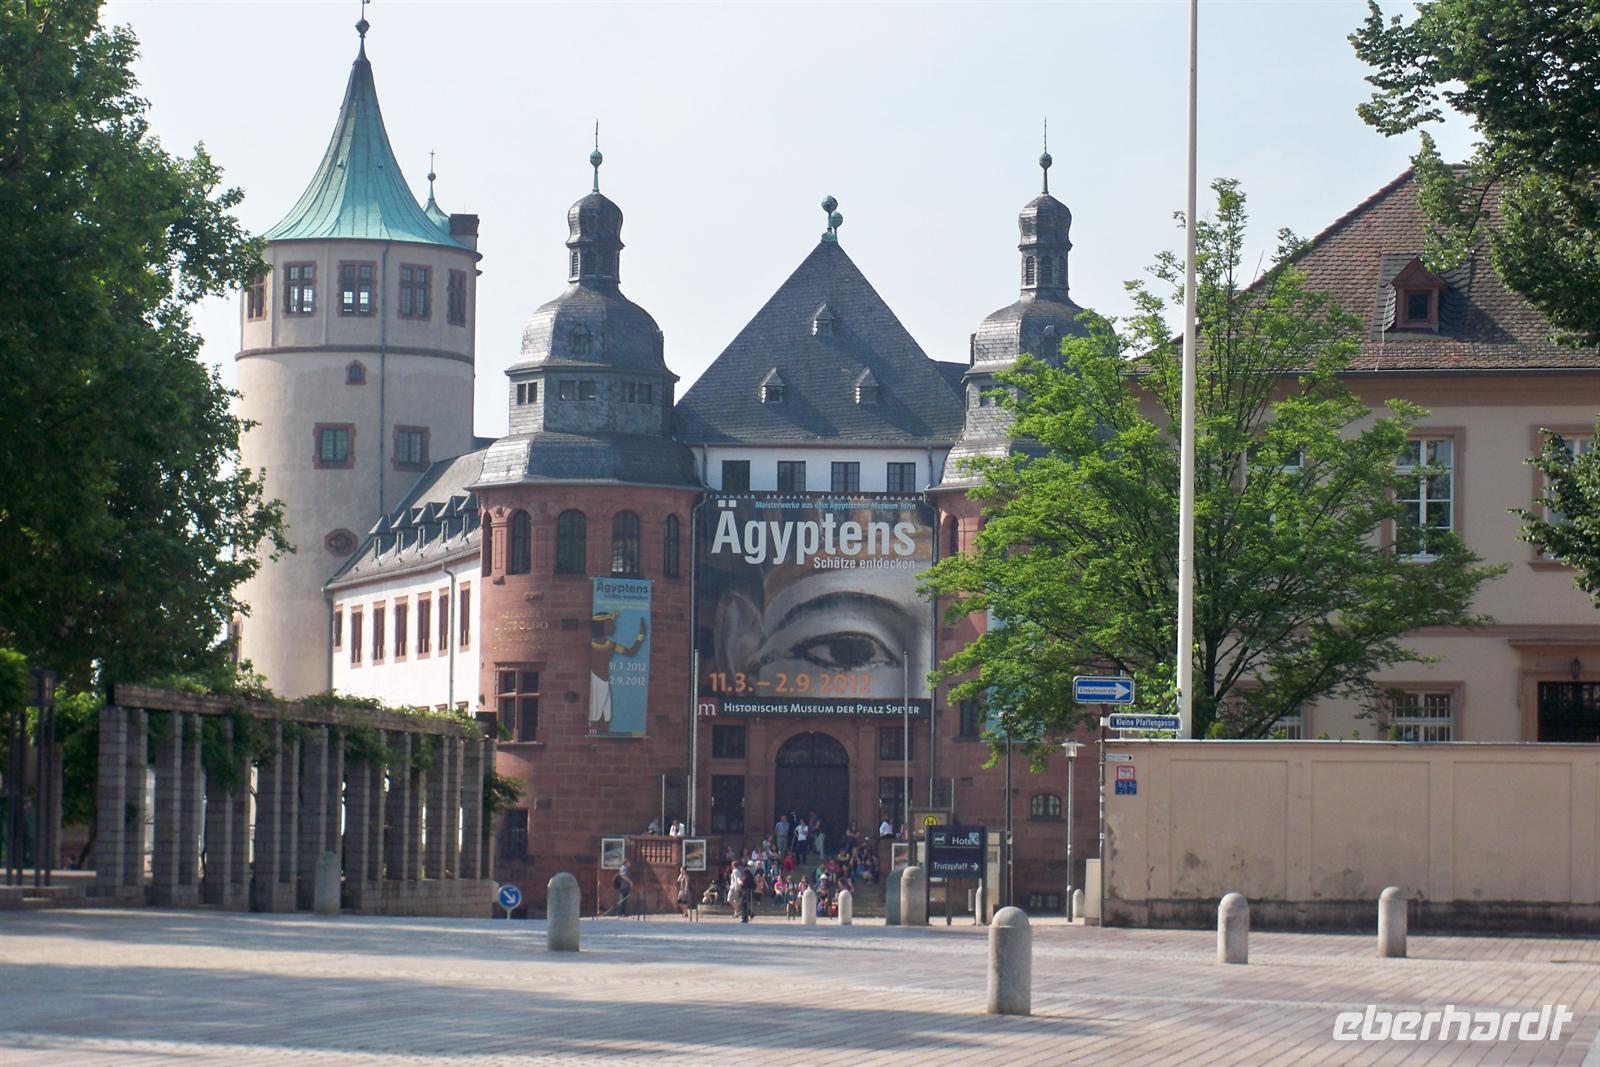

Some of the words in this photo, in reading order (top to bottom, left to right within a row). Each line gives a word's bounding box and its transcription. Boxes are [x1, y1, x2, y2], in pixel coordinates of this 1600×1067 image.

[711, 499, 916, 565] Ägyptens
[814, 556, 856, 569] Schätze
[859, 557, 916, 569] entdecken
[595, 579, 649, 593] Ägyptens
[790, 703, 834, 714] MUSEUM
[1115, 718, 1135, 726] Kleine
[1135, 718, 1176, 728] Pfaffengasse
[933, 862, 968, 871] Trutzpfaff
